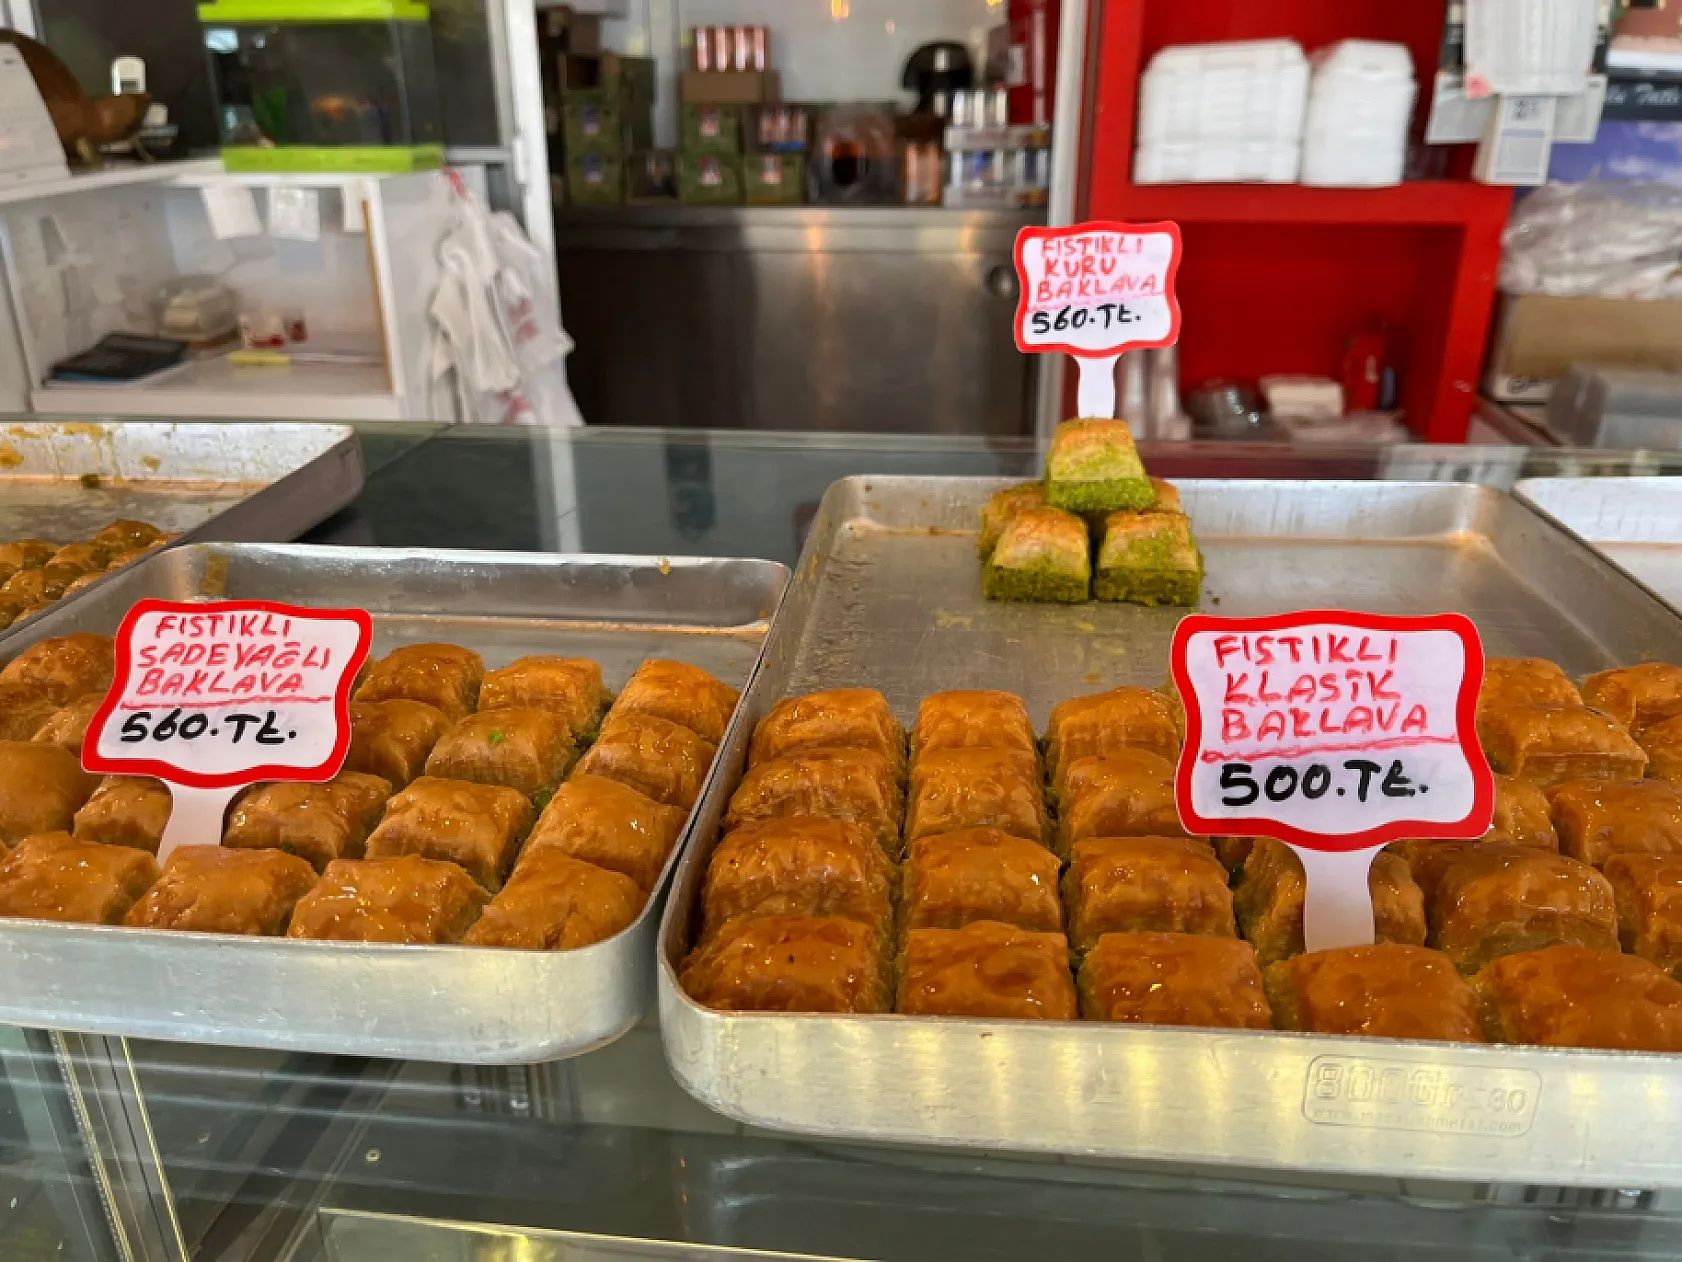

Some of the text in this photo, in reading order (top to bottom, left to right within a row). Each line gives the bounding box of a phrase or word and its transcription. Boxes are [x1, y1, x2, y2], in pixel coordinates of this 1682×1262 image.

[1041, 234, 1144, 258] FISTIKLI
[1044, 254, 1118, 278] KURU
[1036, 272, 1158, 303] BAKLAVA
[154, 613, 292, 640] FISTIKLI
[137, 641, 332, 671] SADEYAĞLI
[1212, 632, 1399, 669] FISTIKLI
[135, 667, 305, 698] BAKLAVA
[1221, 701, 1429, 744] BAKLAVA
